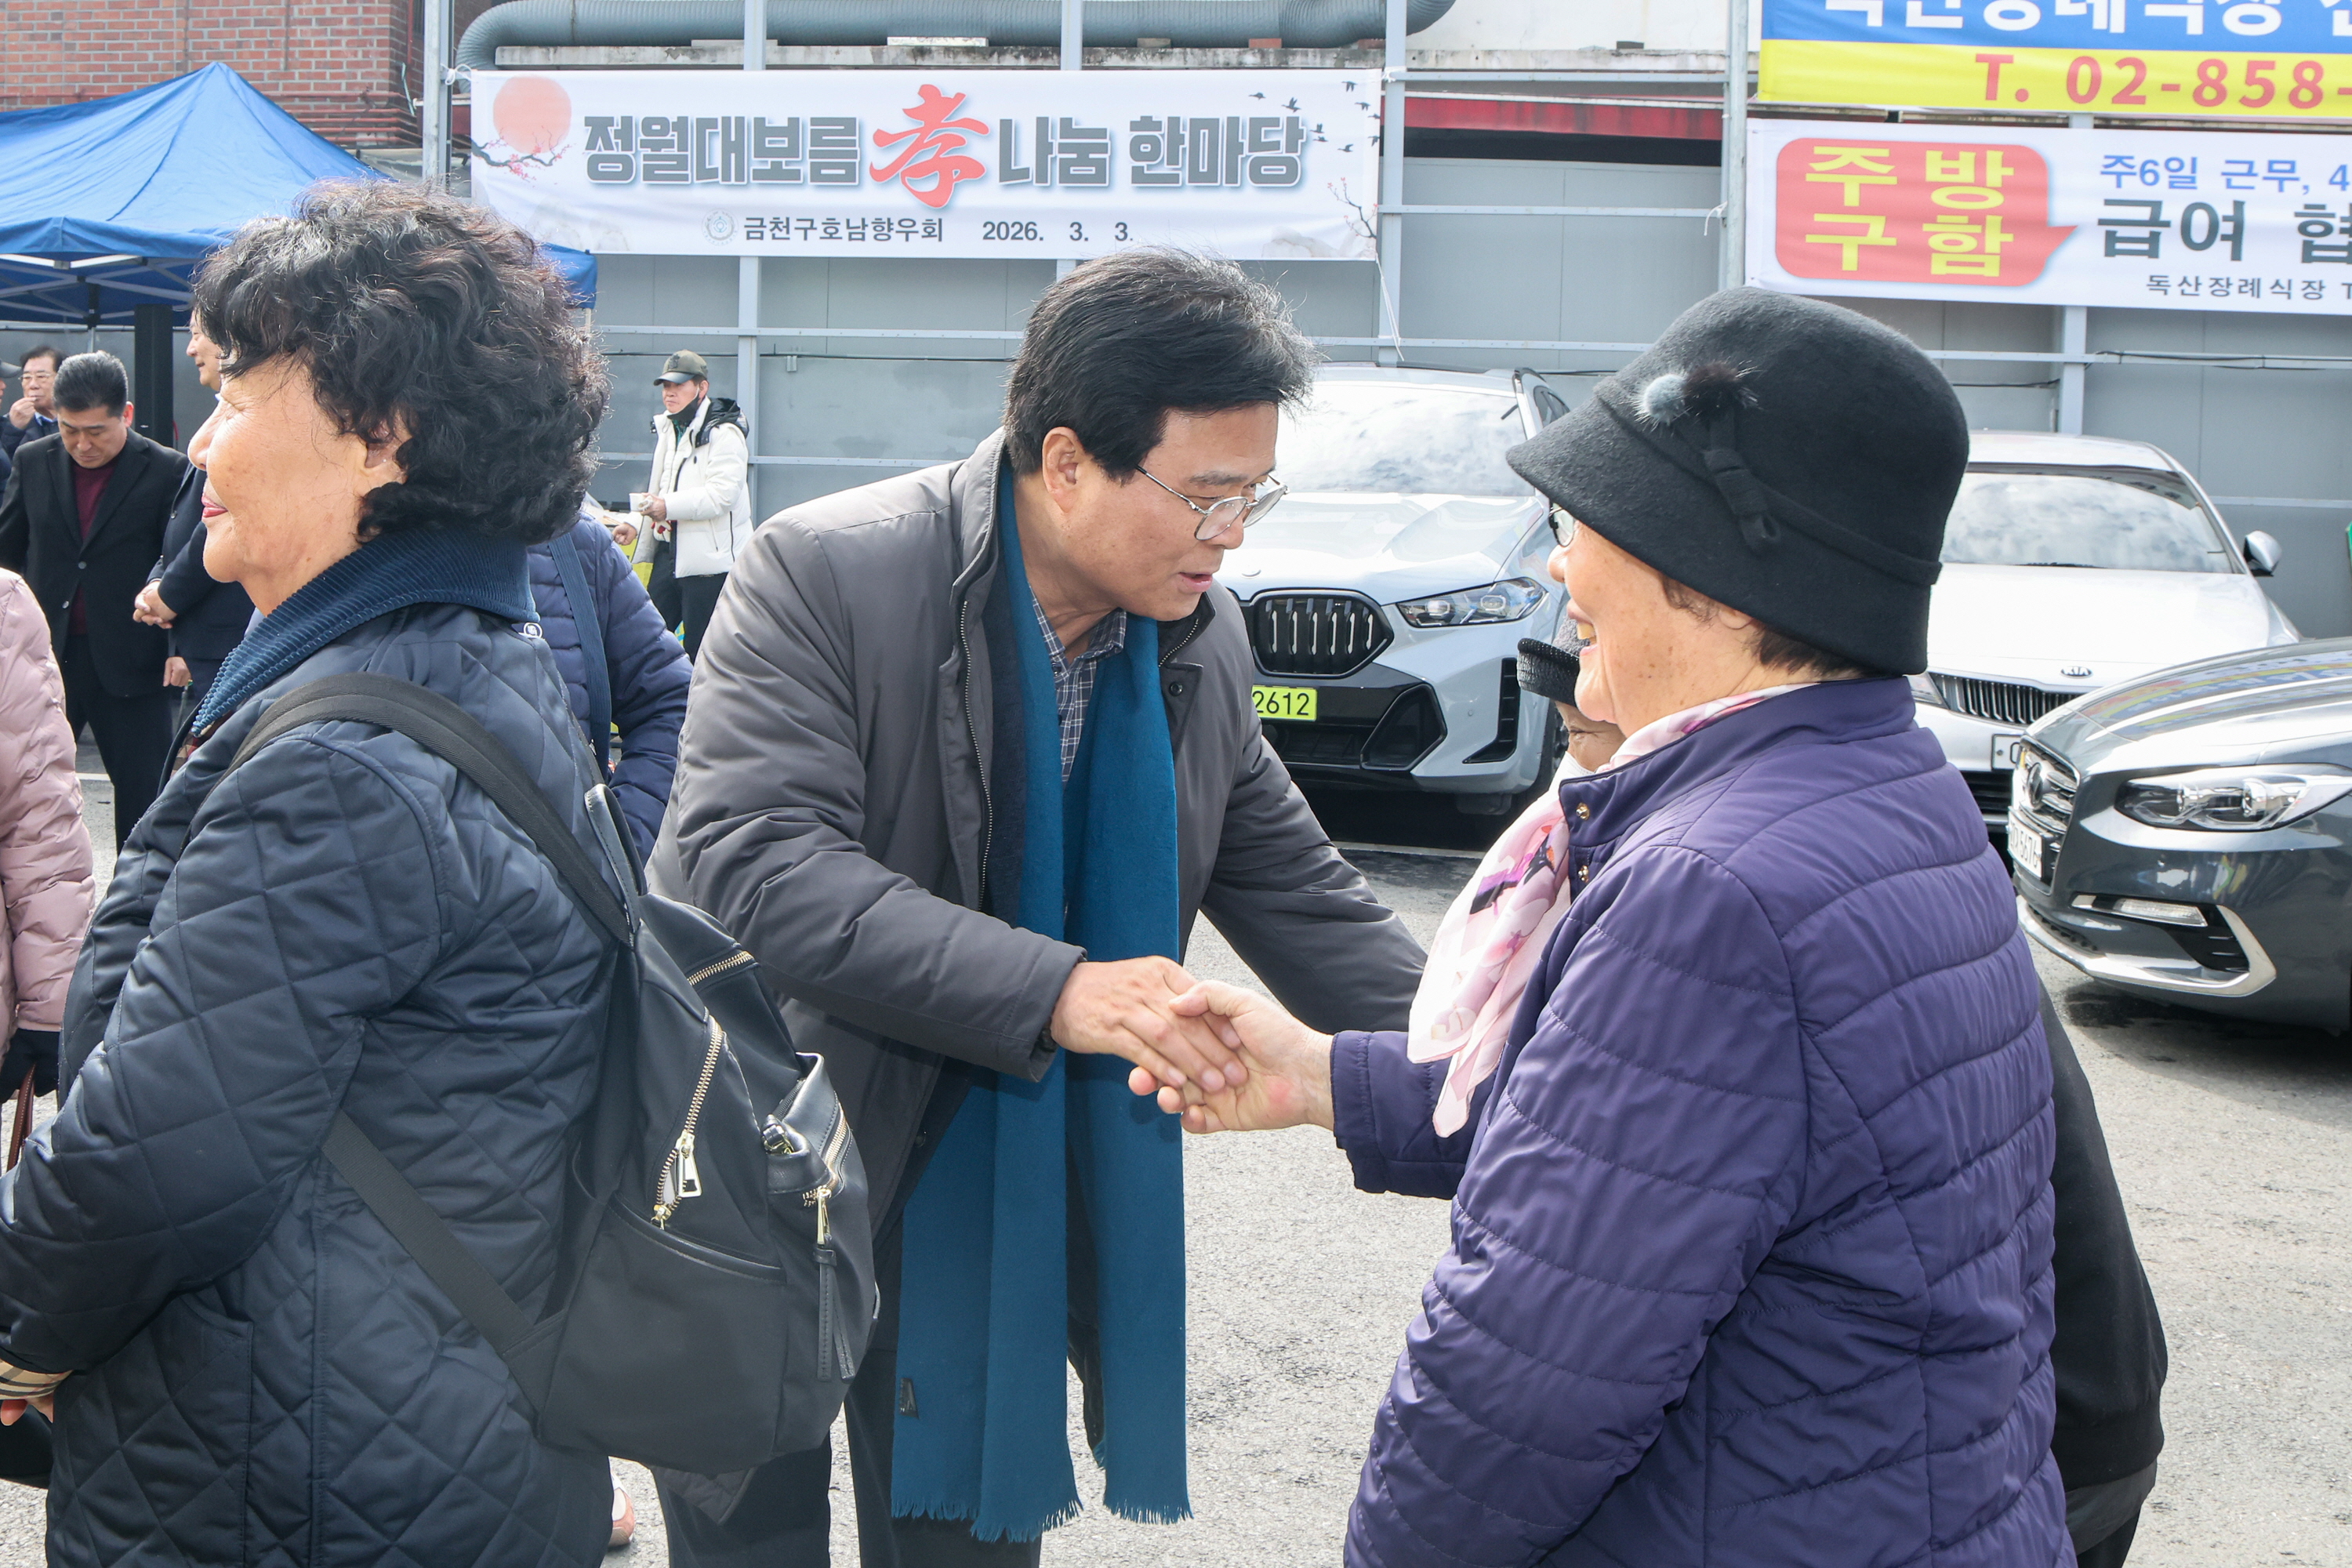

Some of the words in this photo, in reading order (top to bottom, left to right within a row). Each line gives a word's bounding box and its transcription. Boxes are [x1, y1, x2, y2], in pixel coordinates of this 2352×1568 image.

[1976, 53, 2029, 103] T.
[584, 115, 859, 185] 정월대보름
[869, 84, 990, 209] 孝
[998, 116, 1110, 186] 나눔
[1129, 115, 1305, 187] 한마당
[2100, 154, 2198, 190] 주6일
[2221, 159, 2310, 195] 근무,
[743, 216, 943, 242] 금천구호남향우회
[982, 220, 1044, 241] 2026.
[1069, 221, 1089, 242] 3.
[1114, 221, 1134, 242] 3.
[2097, 198, 2246, 262] 급여
[2294, 201, 2352, 265] 협
[2146, 274, 2326, 301] 독산장례식장
[2061, 666, 2091, 677] KIA
[1252, 690, 1309, 716] 2612
